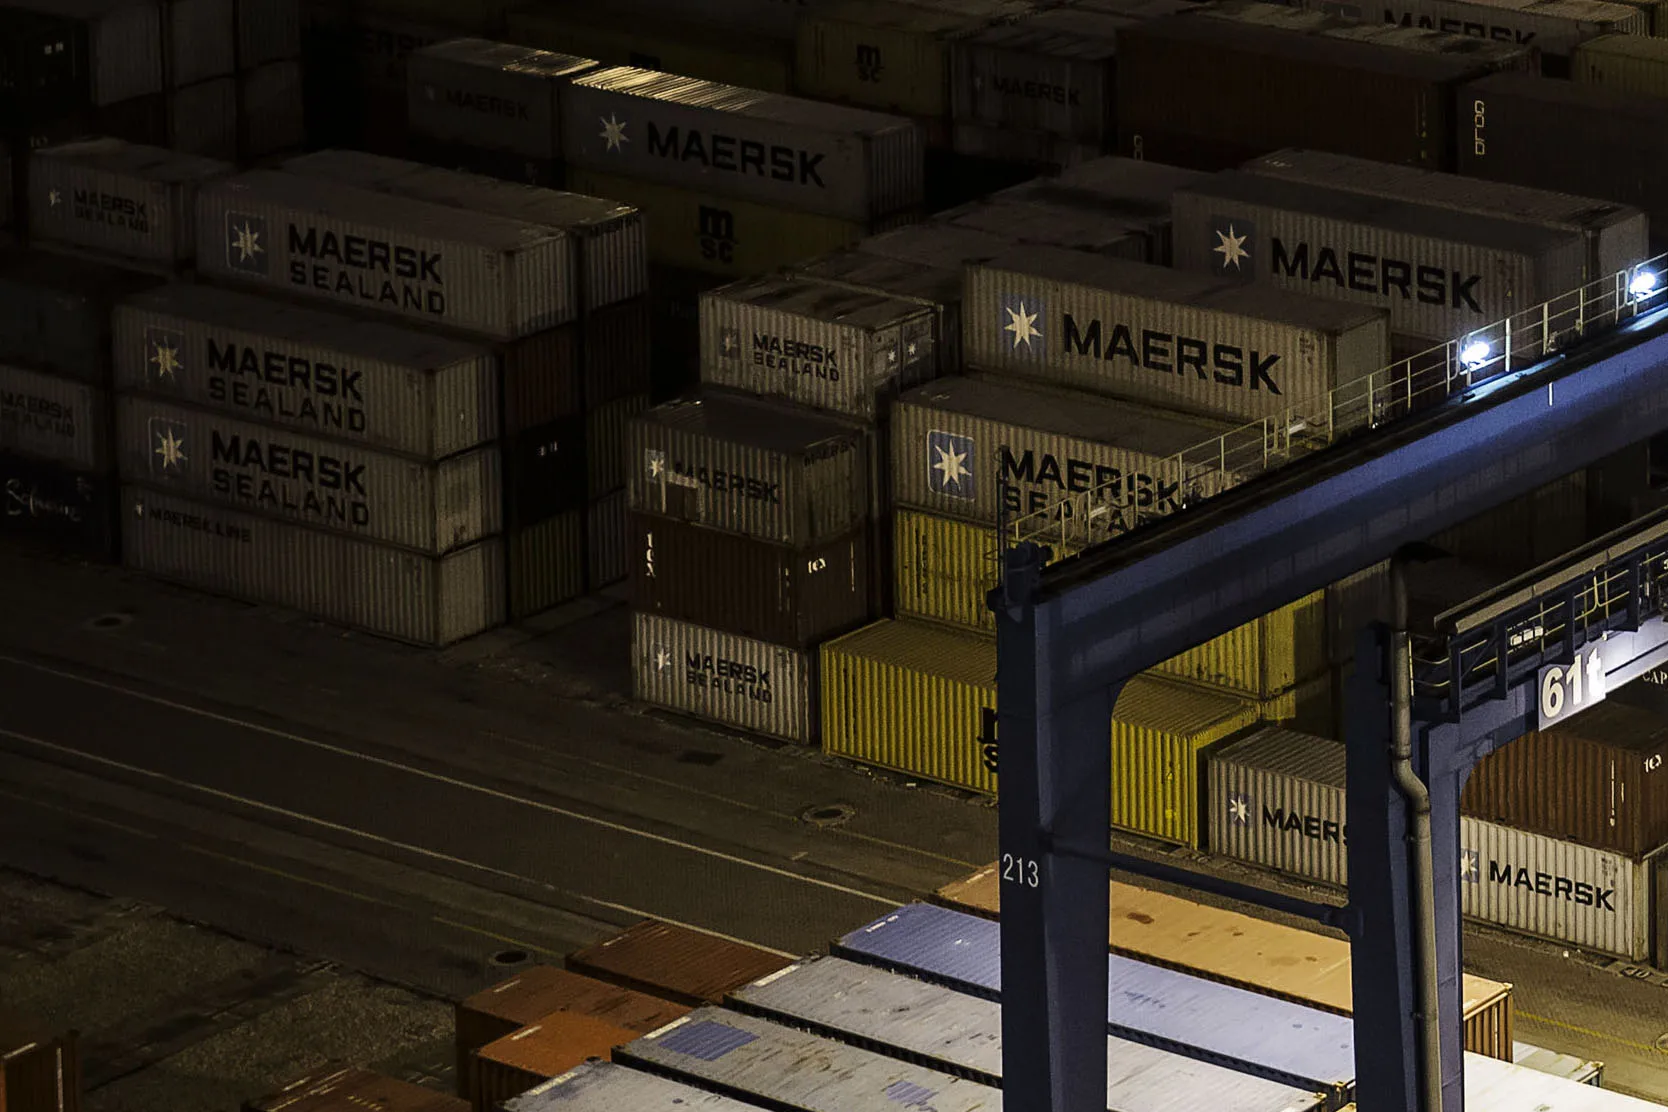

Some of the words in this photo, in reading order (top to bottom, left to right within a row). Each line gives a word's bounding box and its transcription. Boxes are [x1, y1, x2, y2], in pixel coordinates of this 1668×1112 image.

[446, 88, 529, 122] MAERSK
[994, 76, 1081, 107] MAERSK
[647, 120, 826, 189] MAERSK
[1473, 99, 1486, 156] GOLD
[74, 188, 148, 219] MAERSK
[288, 222, 443, 286] MAERSK
[1270, 236, 1484, 314] MAERSK
[290, 260, 446, 316] SEALAND
[207, 338, 363, 402] MAERSK
[752, 333, 838, 367] MAERSK
[753, 351, 841, 383] SEALAND
[1062, 313, 1283, 396] MAERSK
[208, 376, 366, 433] SEALAND
[211, 429, 367, 497] MAERSK
[1000, 444, 1182, 513] MAERSK
[213, 468, 370, 527] SEALAND
[686, 648, 772, 689] MAERSK
[686, 671, 773, 704] SEALAND
[1541, 647, 1602, 719] 61t
[1003, 852, 1041, 889] 213
[1489, 858, 1615, 912] MAERSK
